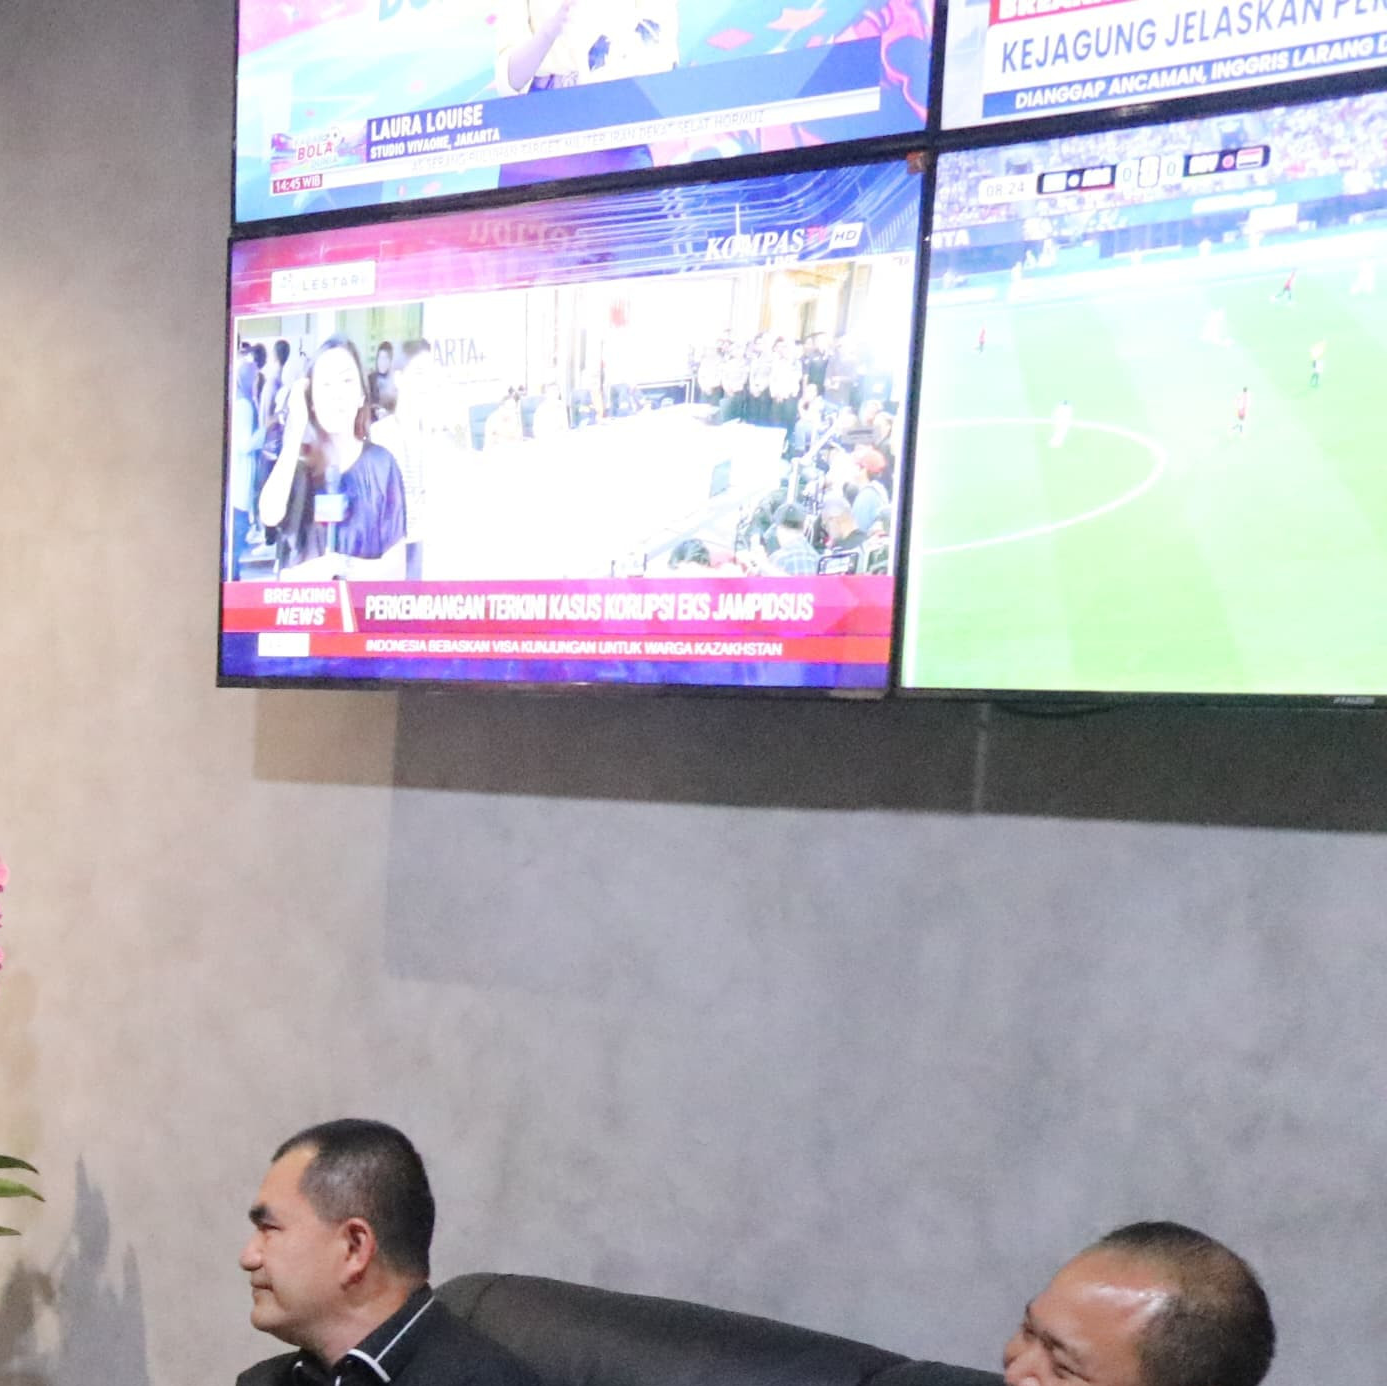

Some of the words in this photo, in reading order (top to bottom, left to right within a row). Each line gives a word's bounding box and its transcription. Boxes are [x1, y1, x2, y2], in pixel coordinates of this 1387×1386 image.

[1002, 18, 1157, 74] KEJAGUNG
[1164, 0, 1324, 47] JELASKAN
[1015, 80, 1106, 109] DIANGGAP
[1108, 64, 1208, 97] ANCAMAN,
[1211, 51, 1290, 81] INGGRIS
[1292, 37, 1374, 69] LARANG
[371, 115, 423, 142] LAURA
[426, 104, 484, 133] LOUISE
[297, 141, 334, 161] BOLA
[370, 141, 405, 160] STUDIO
[453, 128, 501, 148] JAKARTA
[302, 174, 322, 189] WIB
[263, 587, 337, 604] BREAKING
[365, 594, 486, 621] PERKEMBANGAN
[548, 593, 602, 621] KASUS
[603, 592, 675, 621] KORUPSI
[677, 592, 711, 621] EKS
[712, 592, 815, 621] JAMPIDSUS
[275, 606, 326, 626] NEWS
[365, 639, 427, 653] INDONESIA
[427, 639, 491, 654] BEBASKAN
[492, 640, 520, 654] VISA
[520, 640, 597, 655] KUNJUNGAN
[598, 641, 643, 655] UNTUK
[643, 641, 694, 656] WARGA
[693, 641, 784, 657] KAZAKHSTAN
